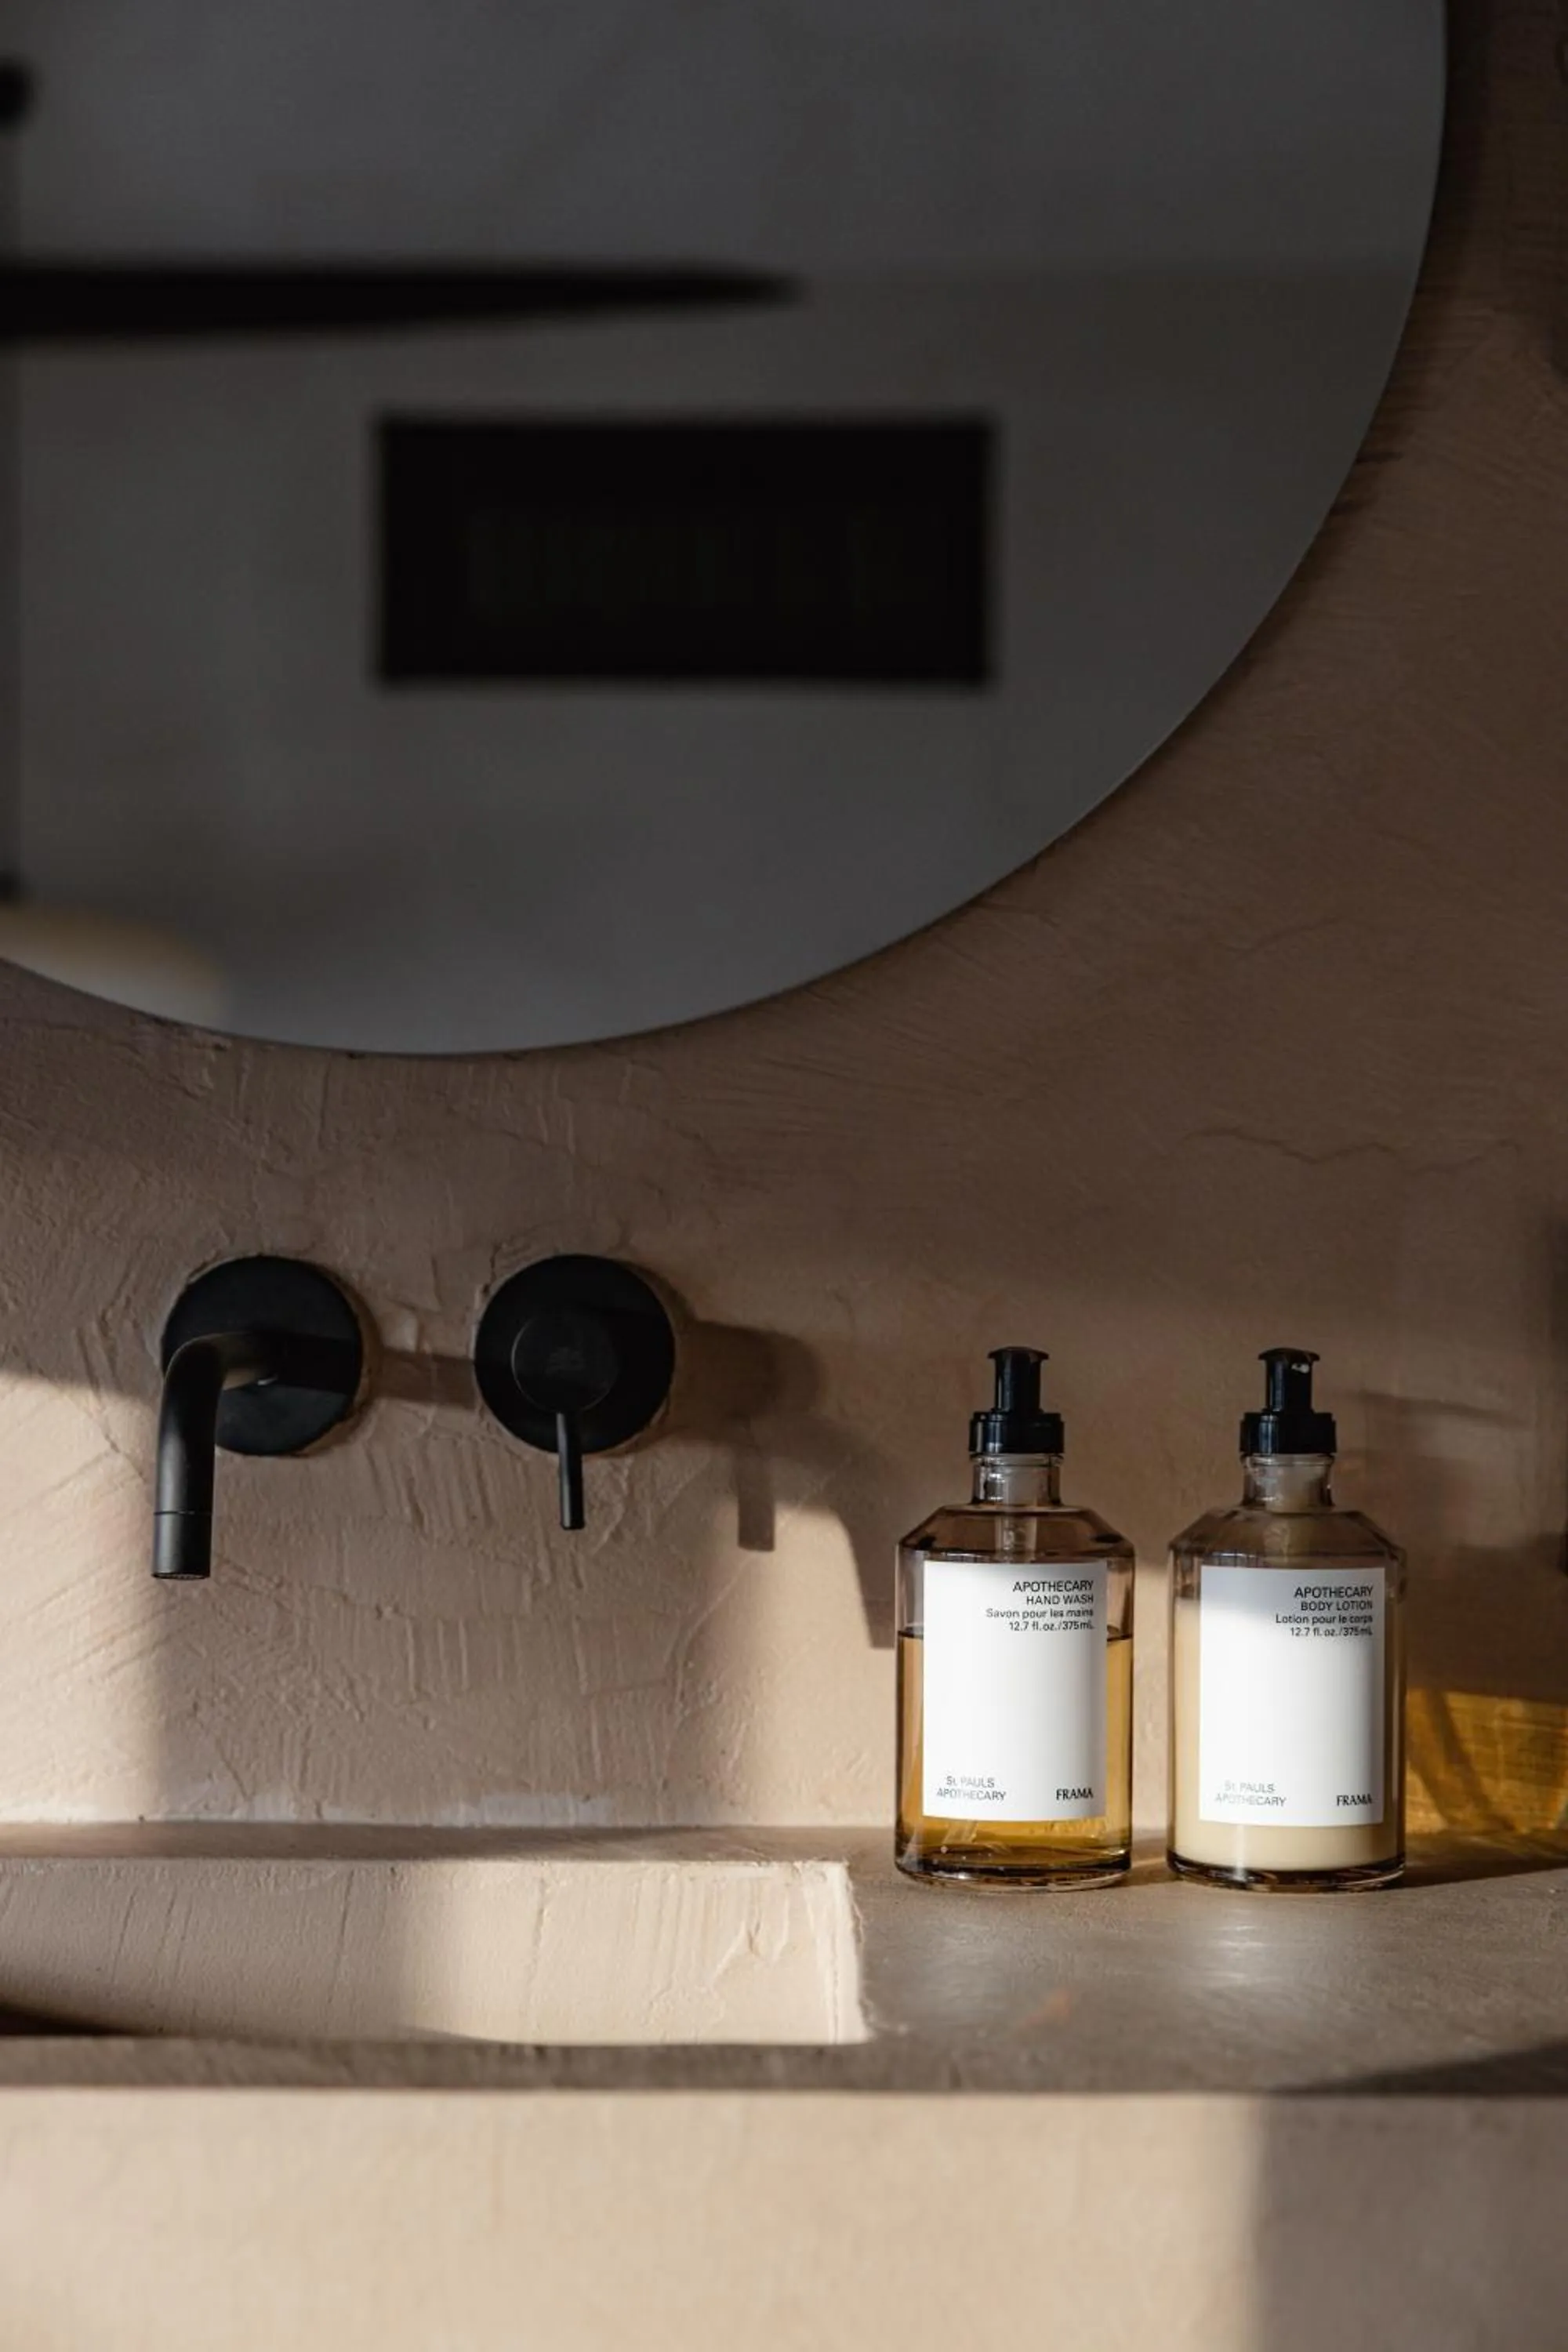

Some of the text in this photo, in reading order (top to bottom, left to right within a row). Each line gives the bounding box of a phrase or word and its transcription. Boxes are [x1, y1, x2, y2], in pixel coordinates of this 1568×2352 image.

[1013, 1580, 1094, 1592] APOTHECARY
[1294, 1585, 1374, 1598] APOTHECARY
[1026, 1594, 1094, 1605] HAND WASH
[1301, 1601, 1373, 1611] BODY LOTION
[985, 1607, 1094, 1620] Savon pour les mains
[1275, 1613, 1374, 1625] Lotion pour le corps
[1009, 1621, 1029, 1632] 12.7
[1290, 1627, 1310, 1637] 12.7
[960, 1777, 995, 1788] PAULS
[1240, 1781, 1276, 1794] PAULS
[936, 1788, 1007, 1801] APOTHECARY
[1055, 1787, 1094, 1801] FRAMA
[1214, 1792, 1287, 1807] APOTHECARY
[1336, 1793, 1373, 1806] FRAMA
